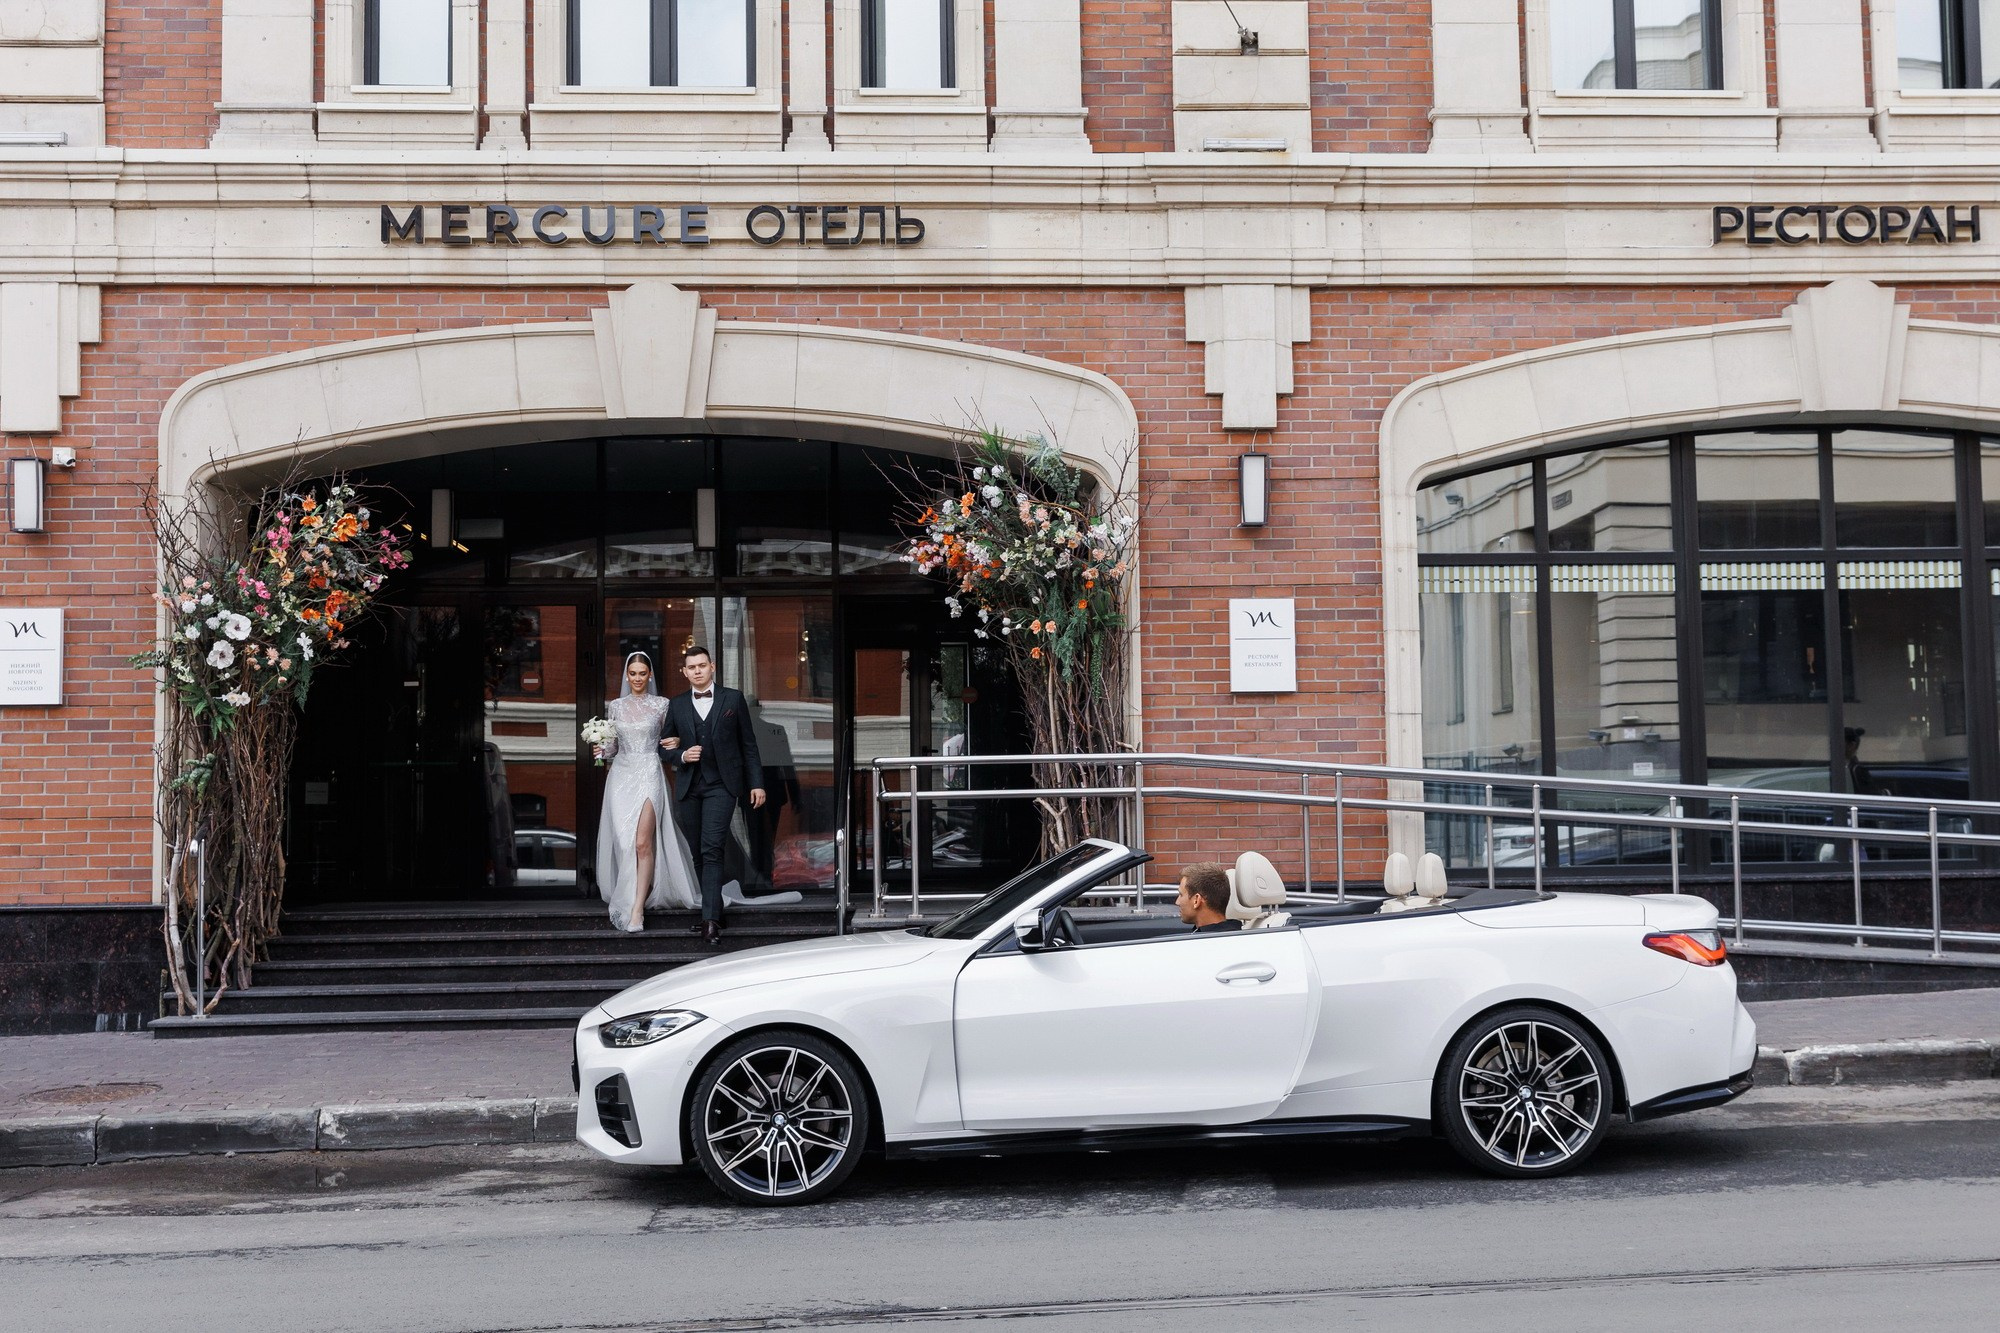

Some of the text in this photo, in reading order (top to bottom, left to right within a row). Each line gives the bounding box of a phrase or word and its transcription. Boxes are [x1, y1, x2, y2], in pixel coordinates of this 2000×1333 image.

[380, 204, 926, 246] MERCURE ОТЕЛЬ
[1713, 205, 1981, 245] РЕСТОРАН
